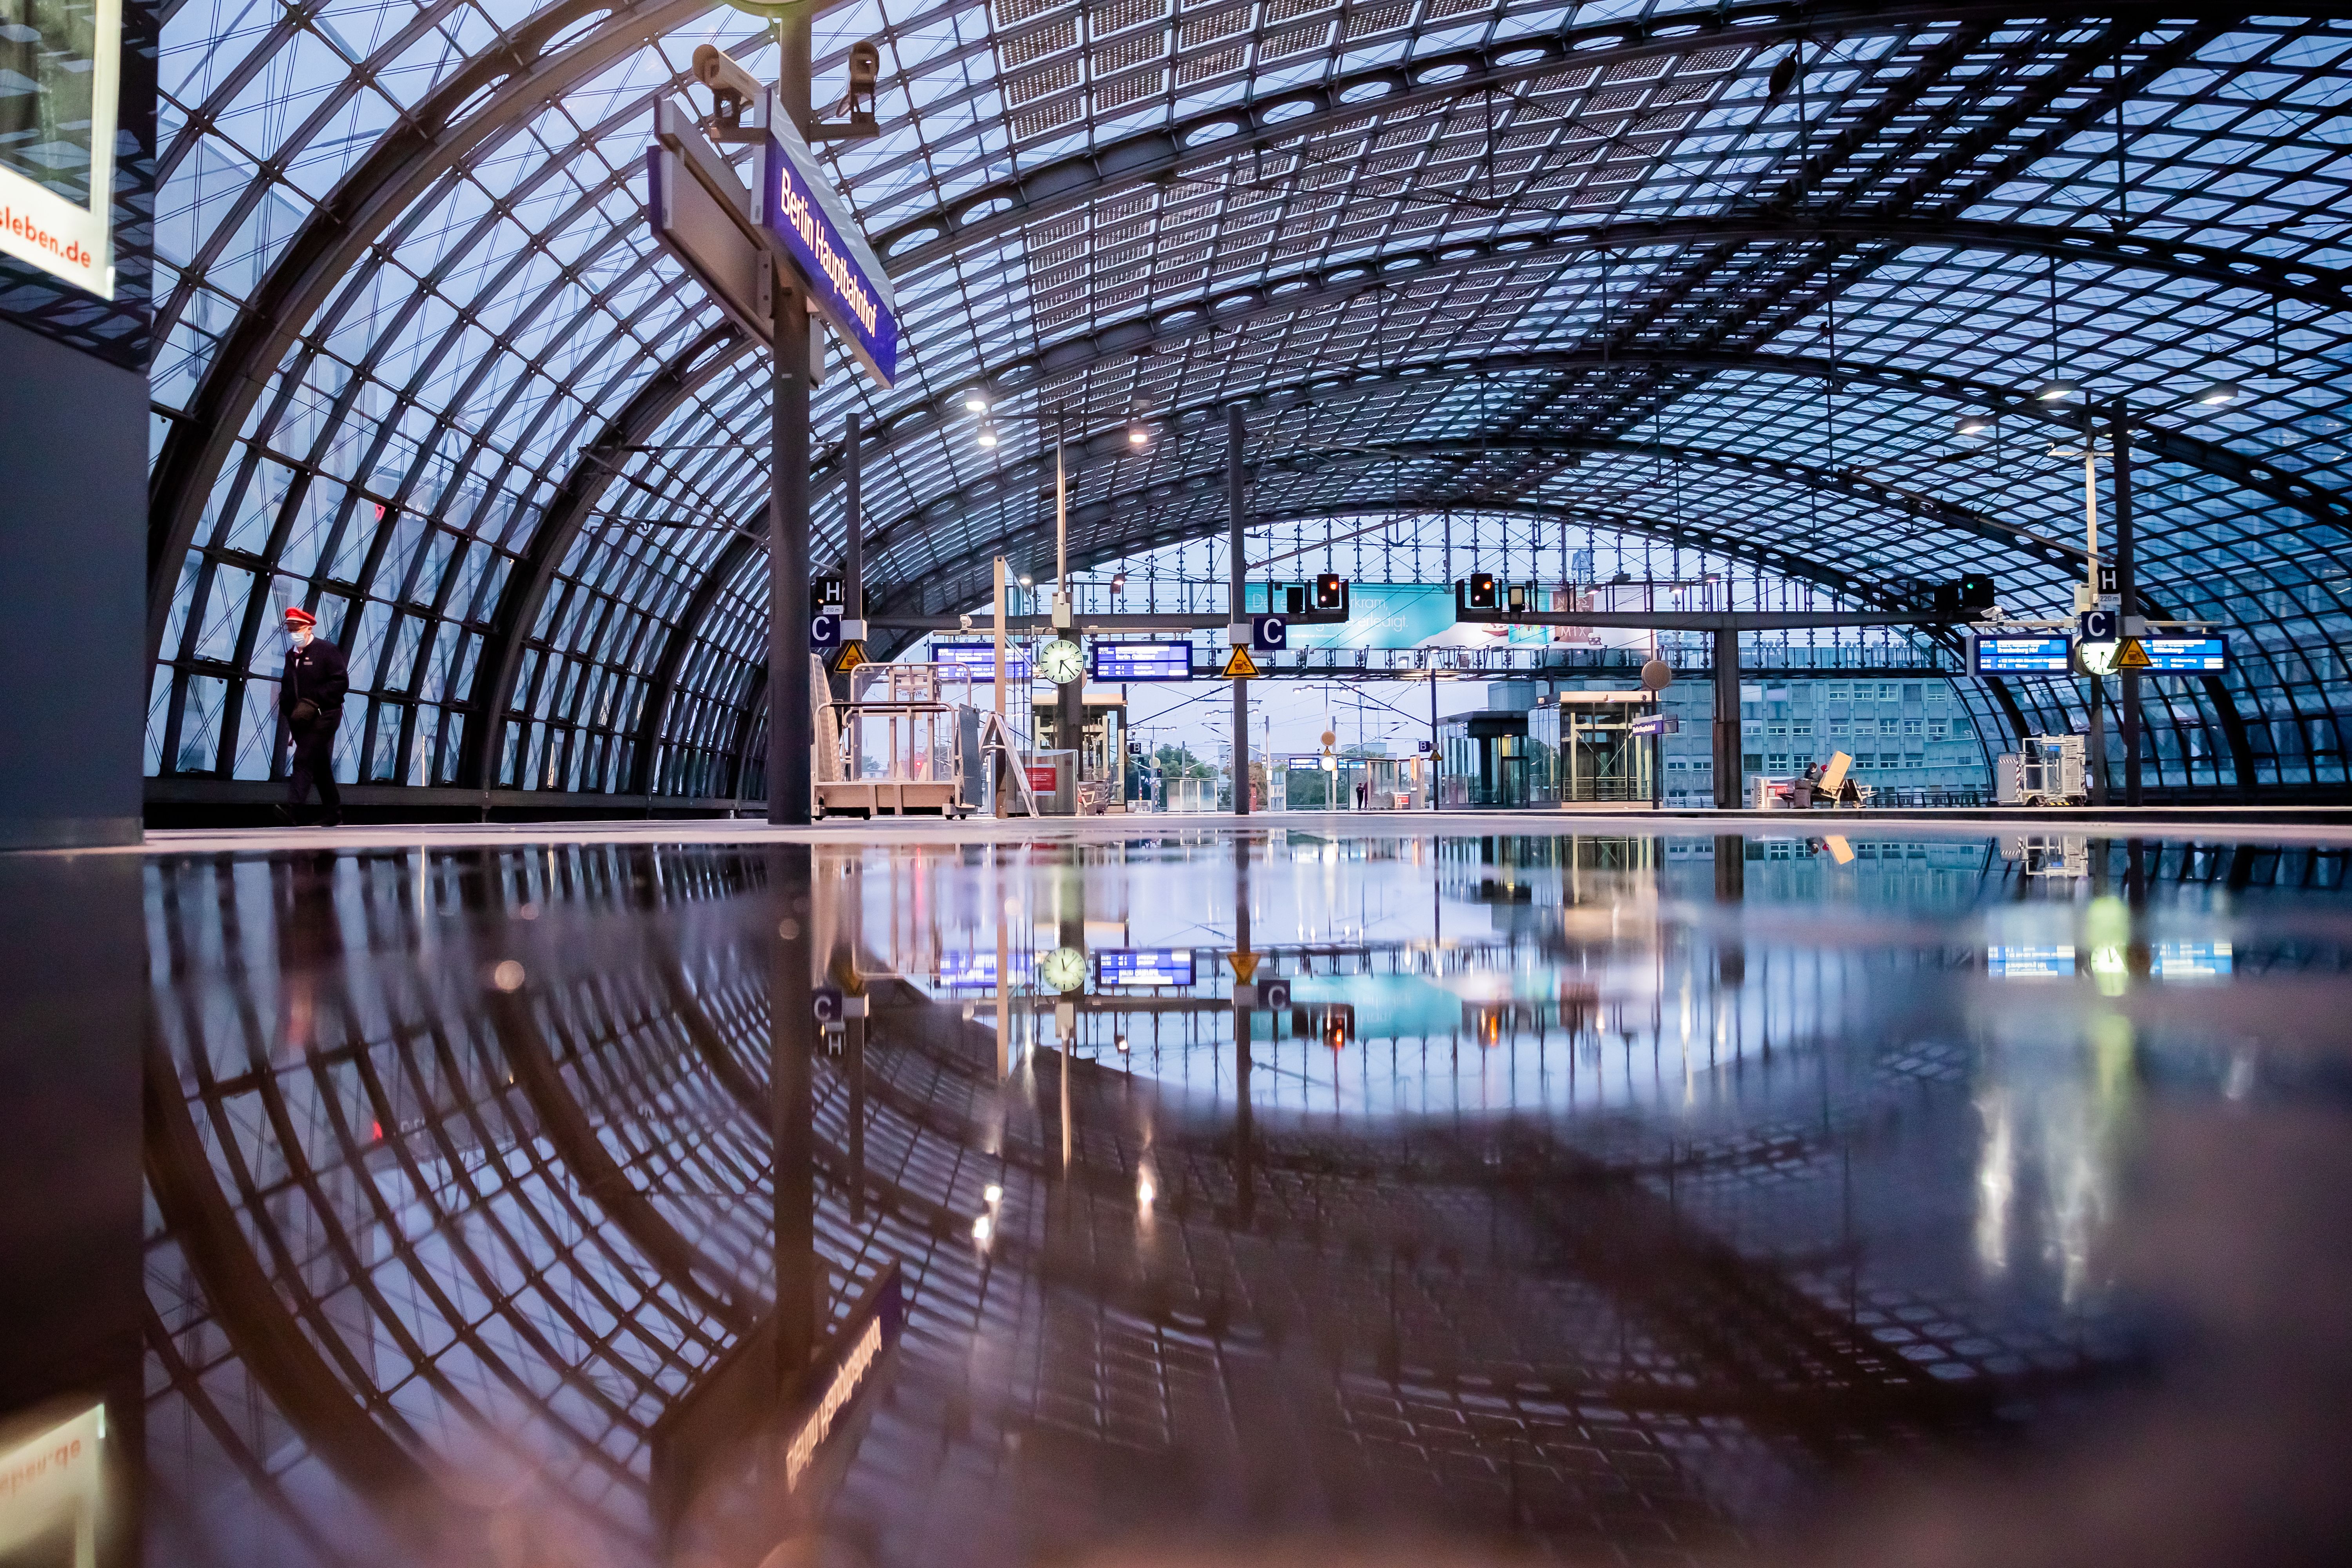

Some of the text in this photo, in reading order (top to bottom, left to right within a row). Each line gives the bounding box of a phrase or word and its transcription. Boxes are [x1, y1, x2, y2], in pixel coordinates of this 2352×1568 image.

[781, 167, 878, 338] Berlin Hauptbahnhof
[2102, 570, 2116, 589] H
[826, 582, 839, 601] H
[812, 616, 830, 641] C
[1264, 618, 1282, 643] C
[1357, 612, 1408, 632] erledigt.
[1561, 626, 1586, 637] MIX
[2088, 612, 2106, 637] C
[1133, 743, 1140, 752] B
[1420, 741, 1426, 750] B
